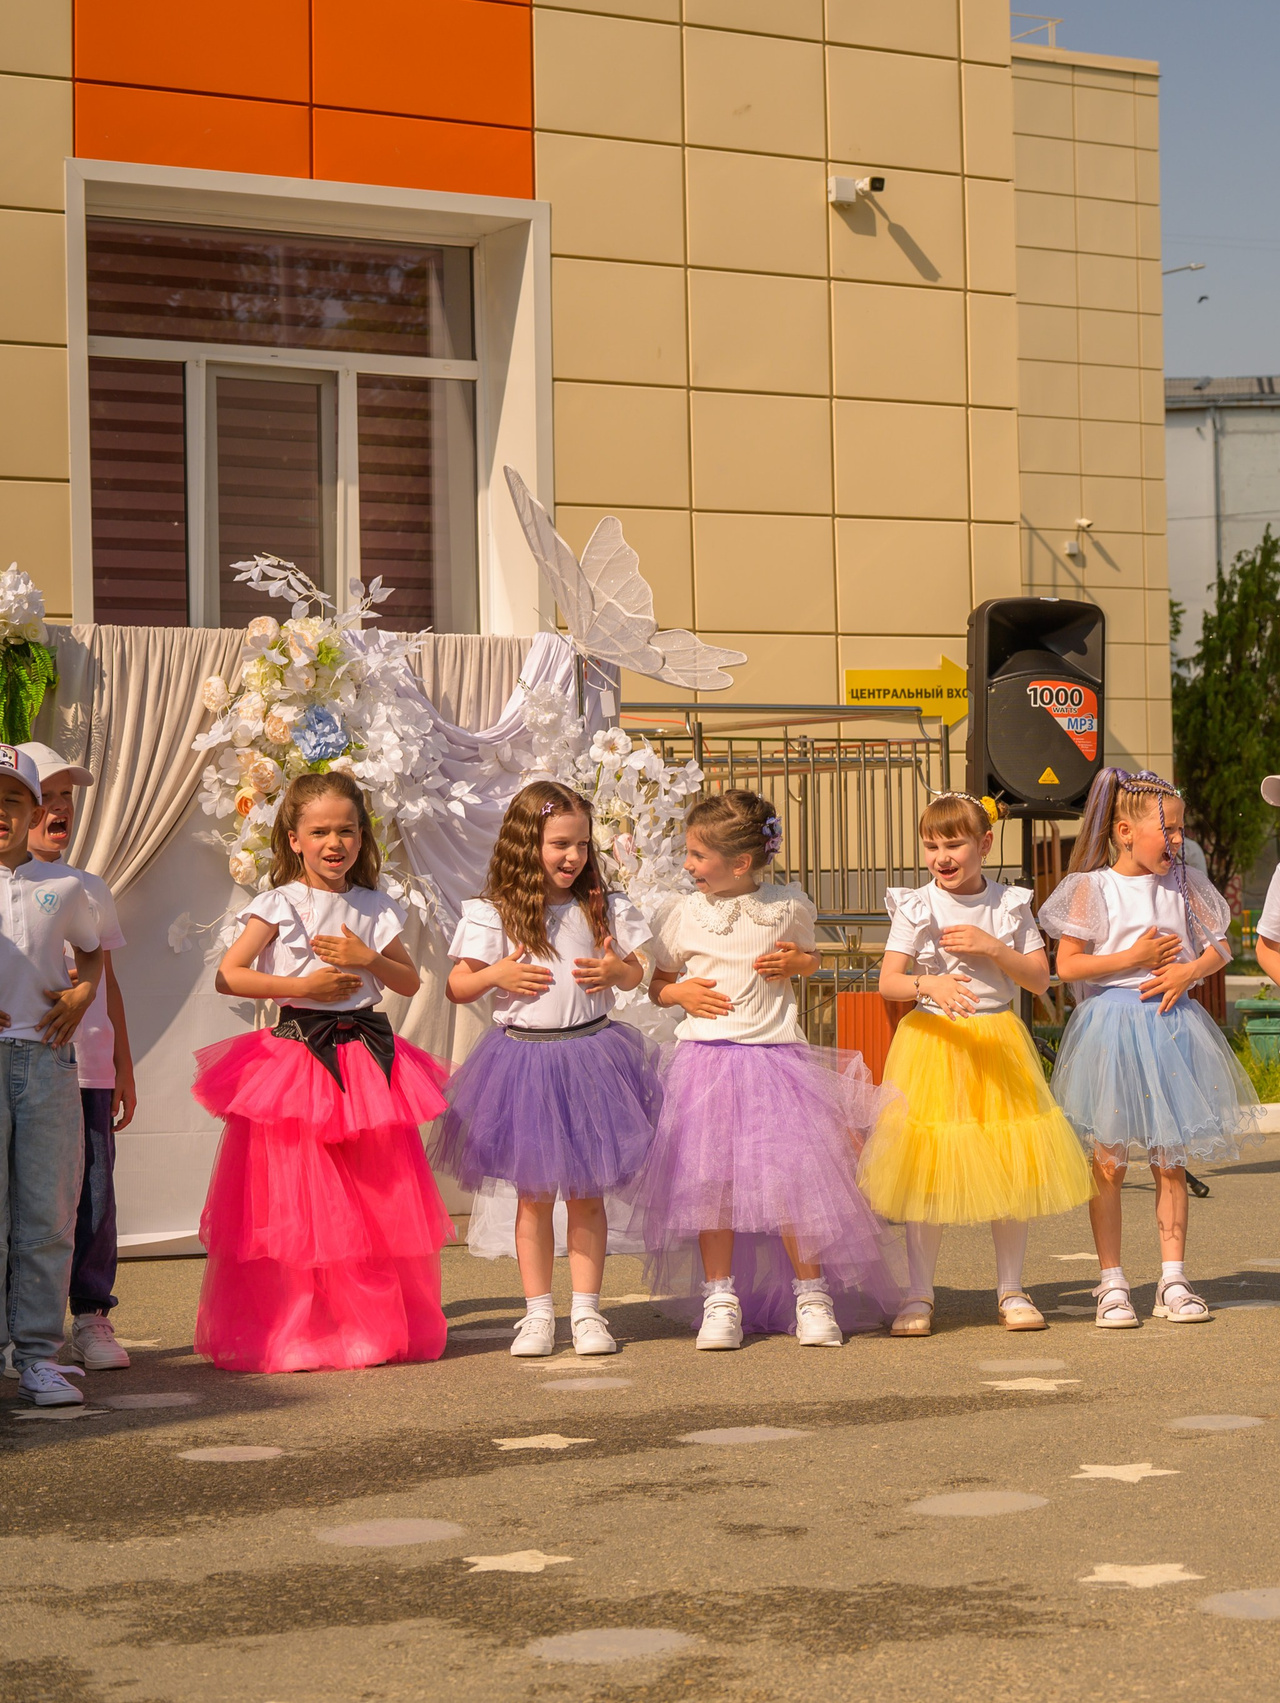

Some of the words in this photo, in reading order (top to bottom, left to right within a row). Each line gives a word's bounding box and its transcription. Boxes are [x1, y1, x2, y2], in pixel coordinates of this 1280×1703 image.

[850, 685, 943, 701] ЦЕНТРАЛЬНЫЙ
[1027, 686, 1084, 708] 1000
[1067, 717, 1094, 731] MP3
